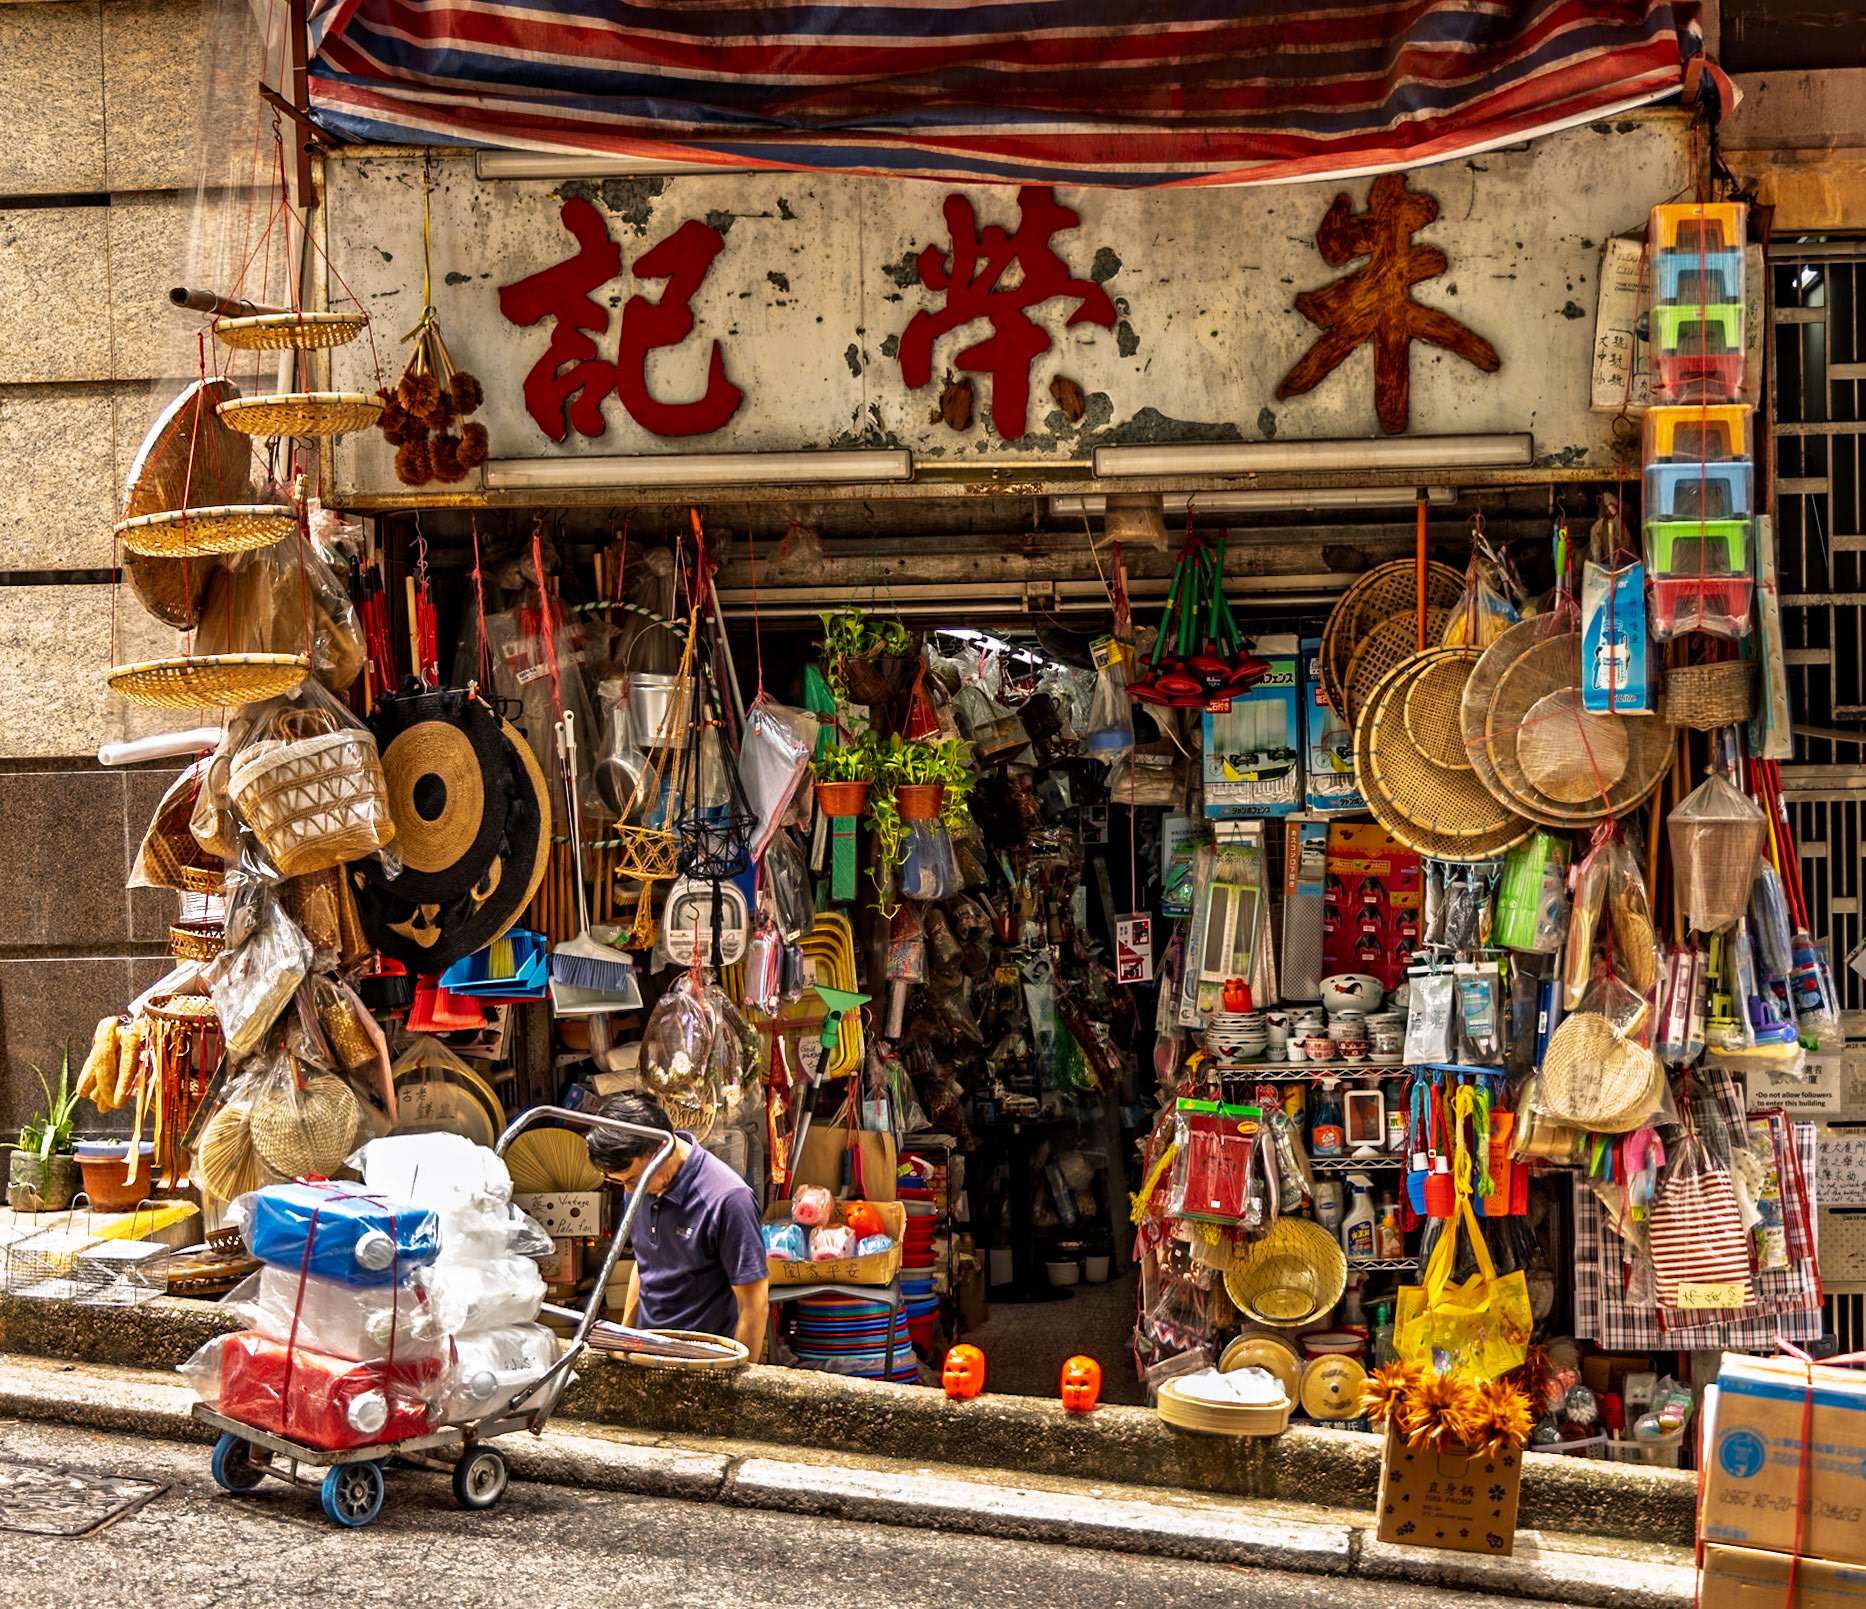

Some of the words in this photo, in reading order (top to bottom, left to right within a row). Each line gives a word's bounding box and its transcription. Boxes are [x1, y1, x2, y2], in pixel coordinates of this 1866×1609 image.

[1799, 1100, 1826, 1108] building
[558, 1194, 591, 1207] Vintage
[556, 1219, 574, 1233] Palm
[577, 1218, 593, 1233] fan
[1425, 1494, 1441, 1503] FIRE
[1445, 1496, 1472, 1505] PROOF
